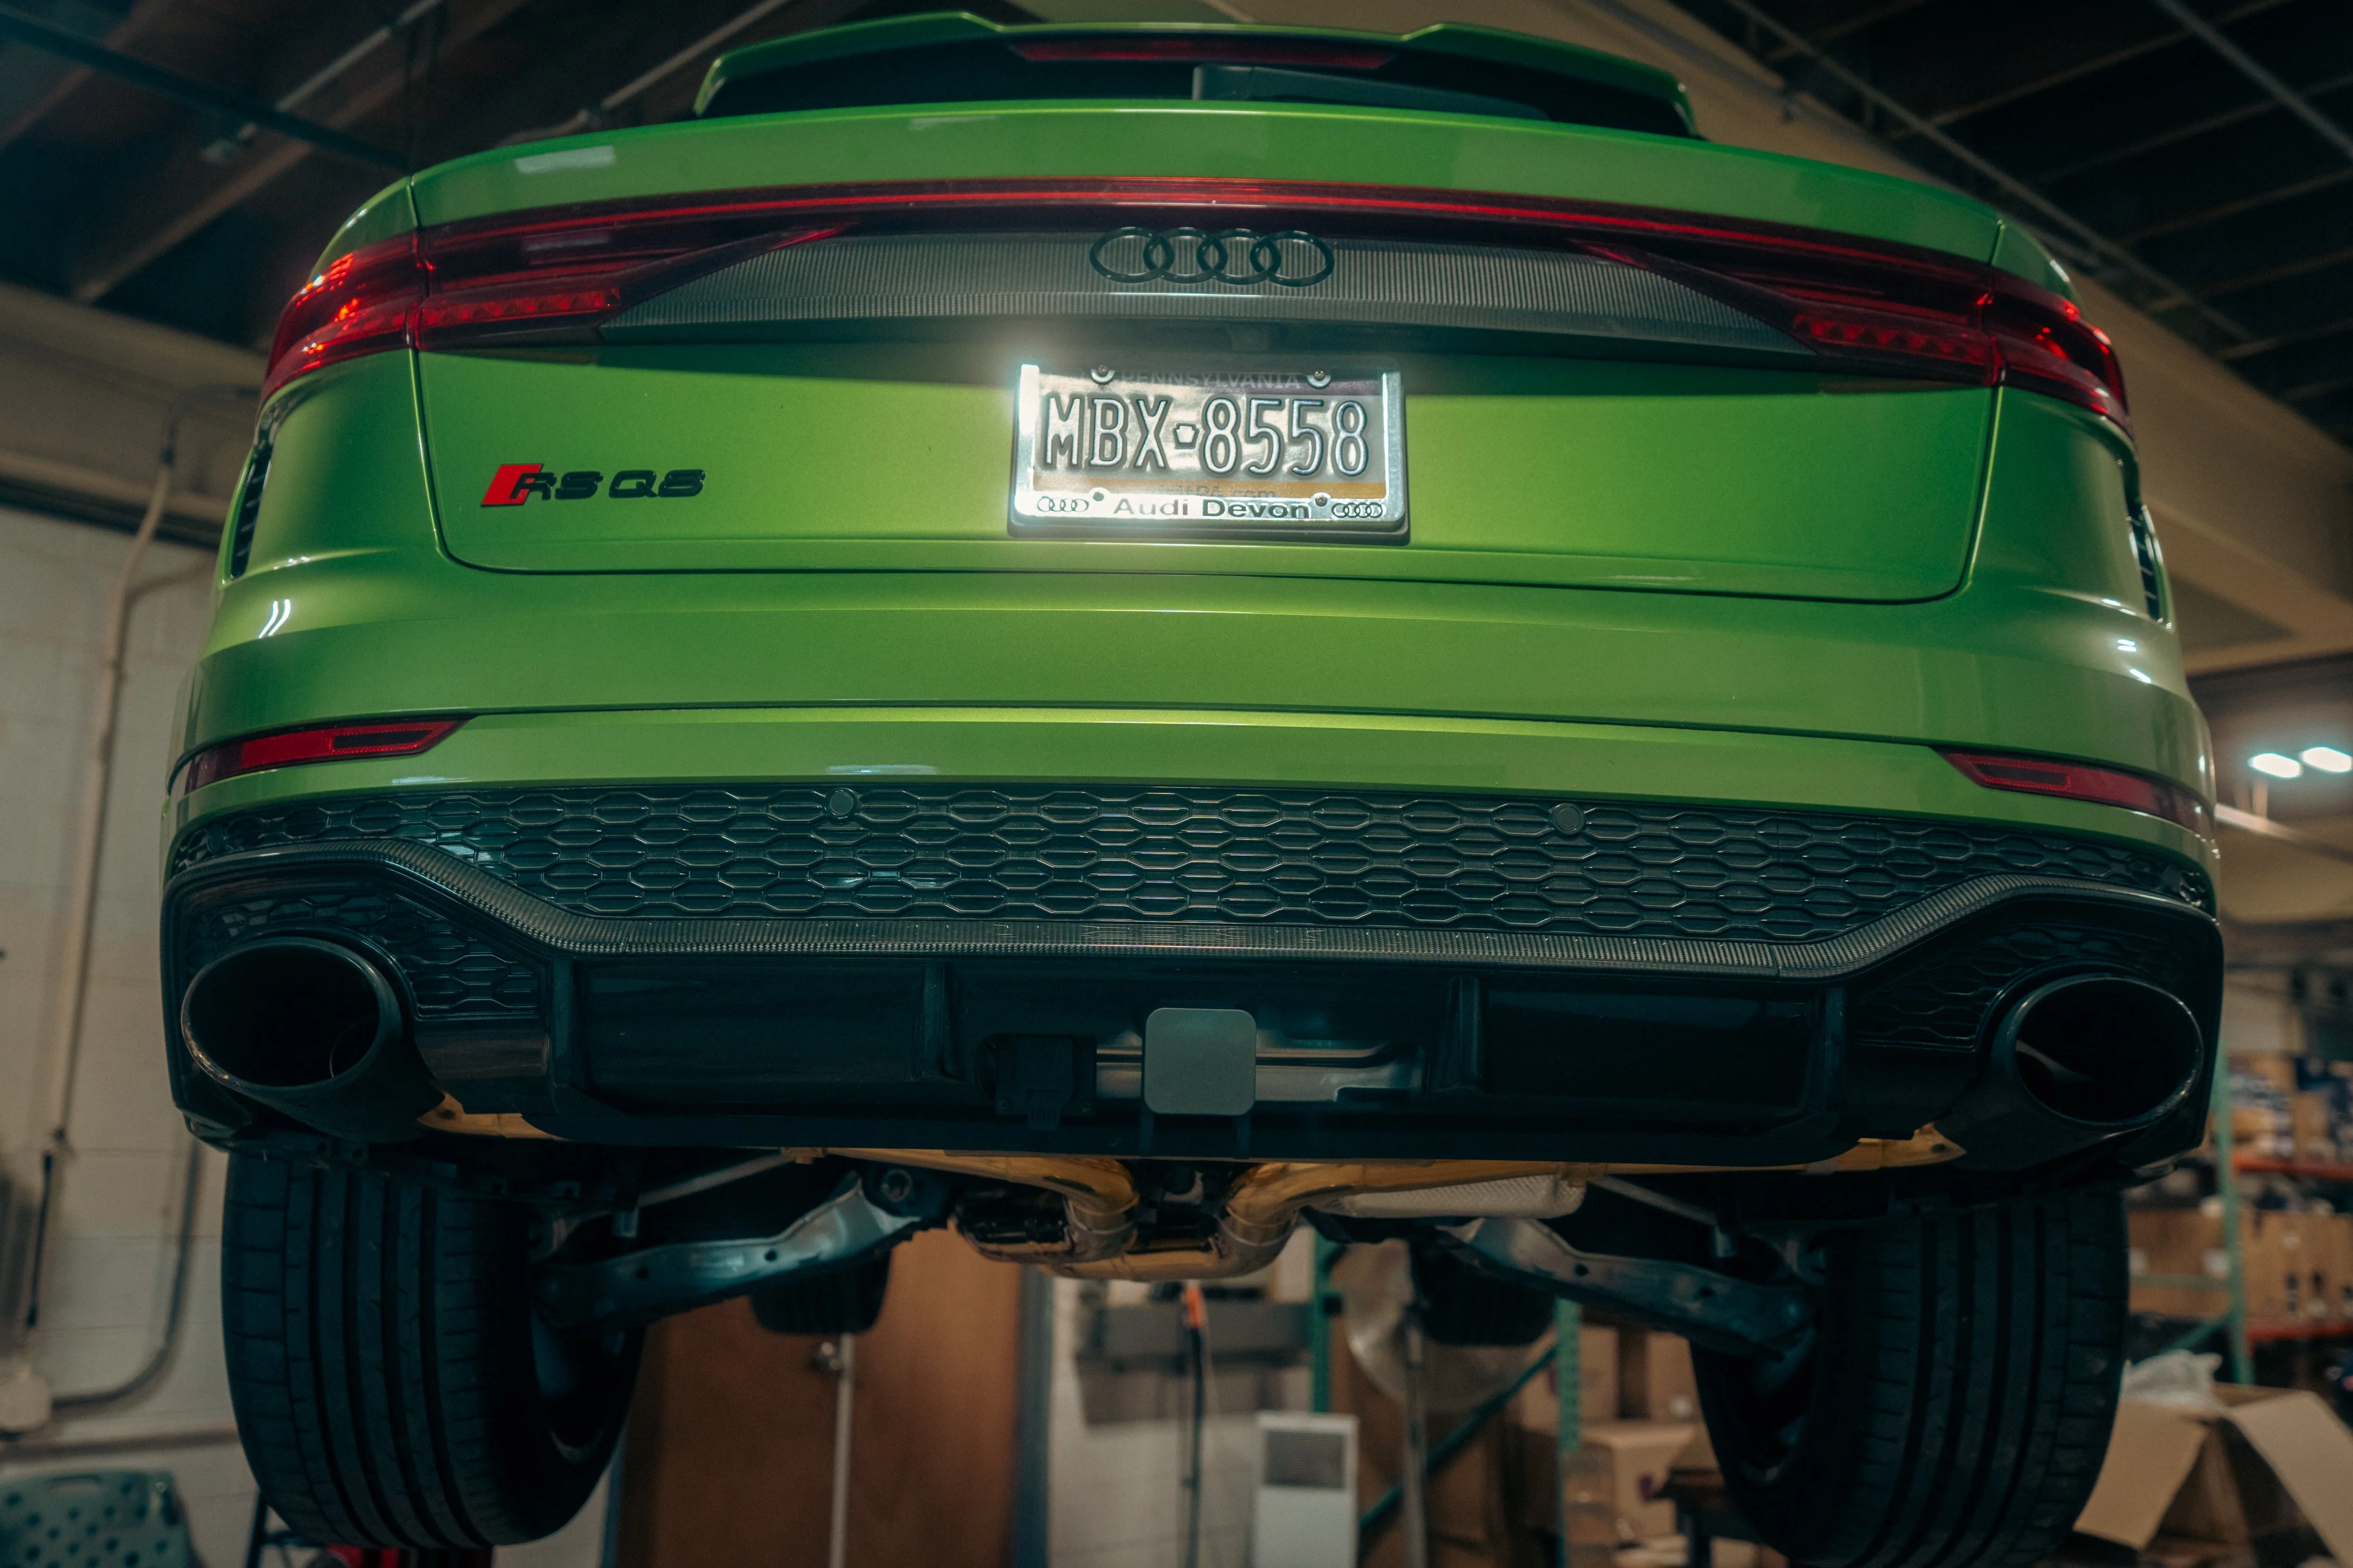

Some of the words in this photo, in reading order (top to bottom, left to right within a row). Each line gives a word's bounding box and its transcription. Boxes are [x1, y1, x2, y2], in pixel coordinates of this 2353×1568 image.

[1121, 371, 1301, 389] PENNSYLVANIA
[1043, 397, 1168, 469] MBX
[1203, 397, 1369, 477] 8558
[509, 472, 604, 500] RS
[609, 469, 706, 498] Q8
[1113, 498, 1189, 515] Audi
[1202, 499, 1310, 519] Devon
